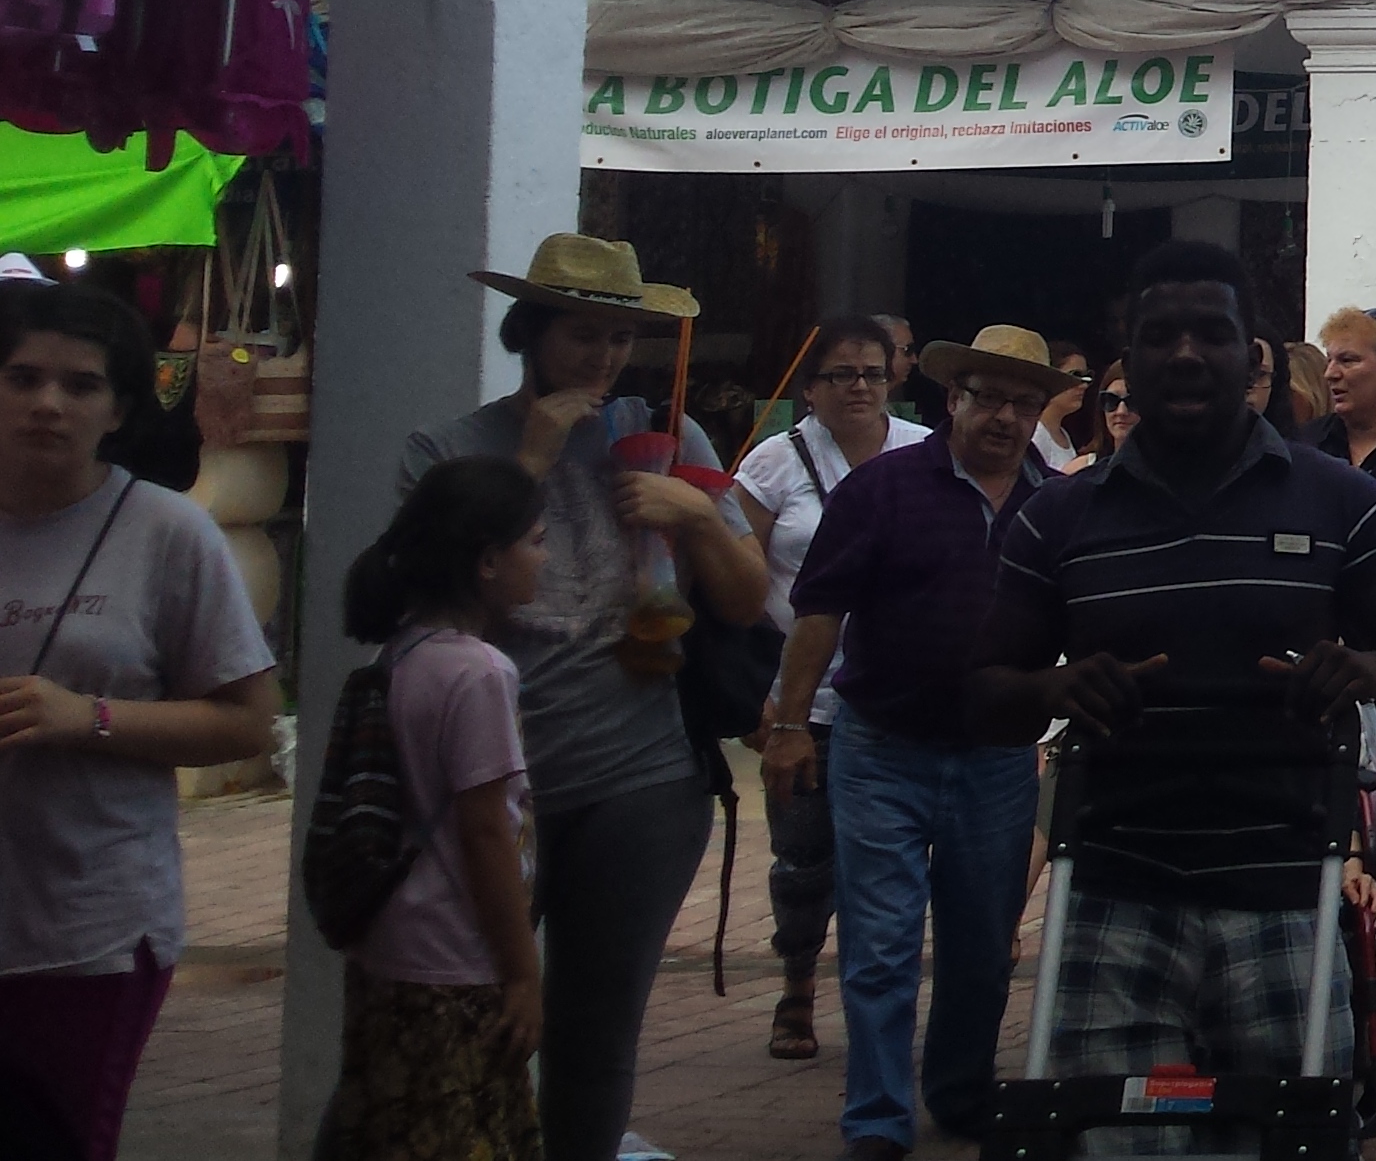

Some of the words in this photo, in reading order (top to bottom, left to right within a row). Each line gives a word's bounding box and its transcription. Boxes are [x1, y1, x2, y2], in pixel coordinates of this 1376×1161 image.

[582, 76, 625, 115] A
[644, 66, 896, 115] BOTIGA
[913, 63, 1028, 114] DEL
[1045, 55, 1215, 108] ALOE
[1113, 119, 1170, 132] ACTIValoe
[1234, 92, 1310, 133] DEL
[628, 126, 697, 140] Naturales
[705, 127, 828, 142] aloeveraplanet.com
[835, 126, 870, 142] Elige
[874, 125, 888, 140] el
[891, 124, 949, 141] original,
[951, 122, 1006, 138] rechaza
